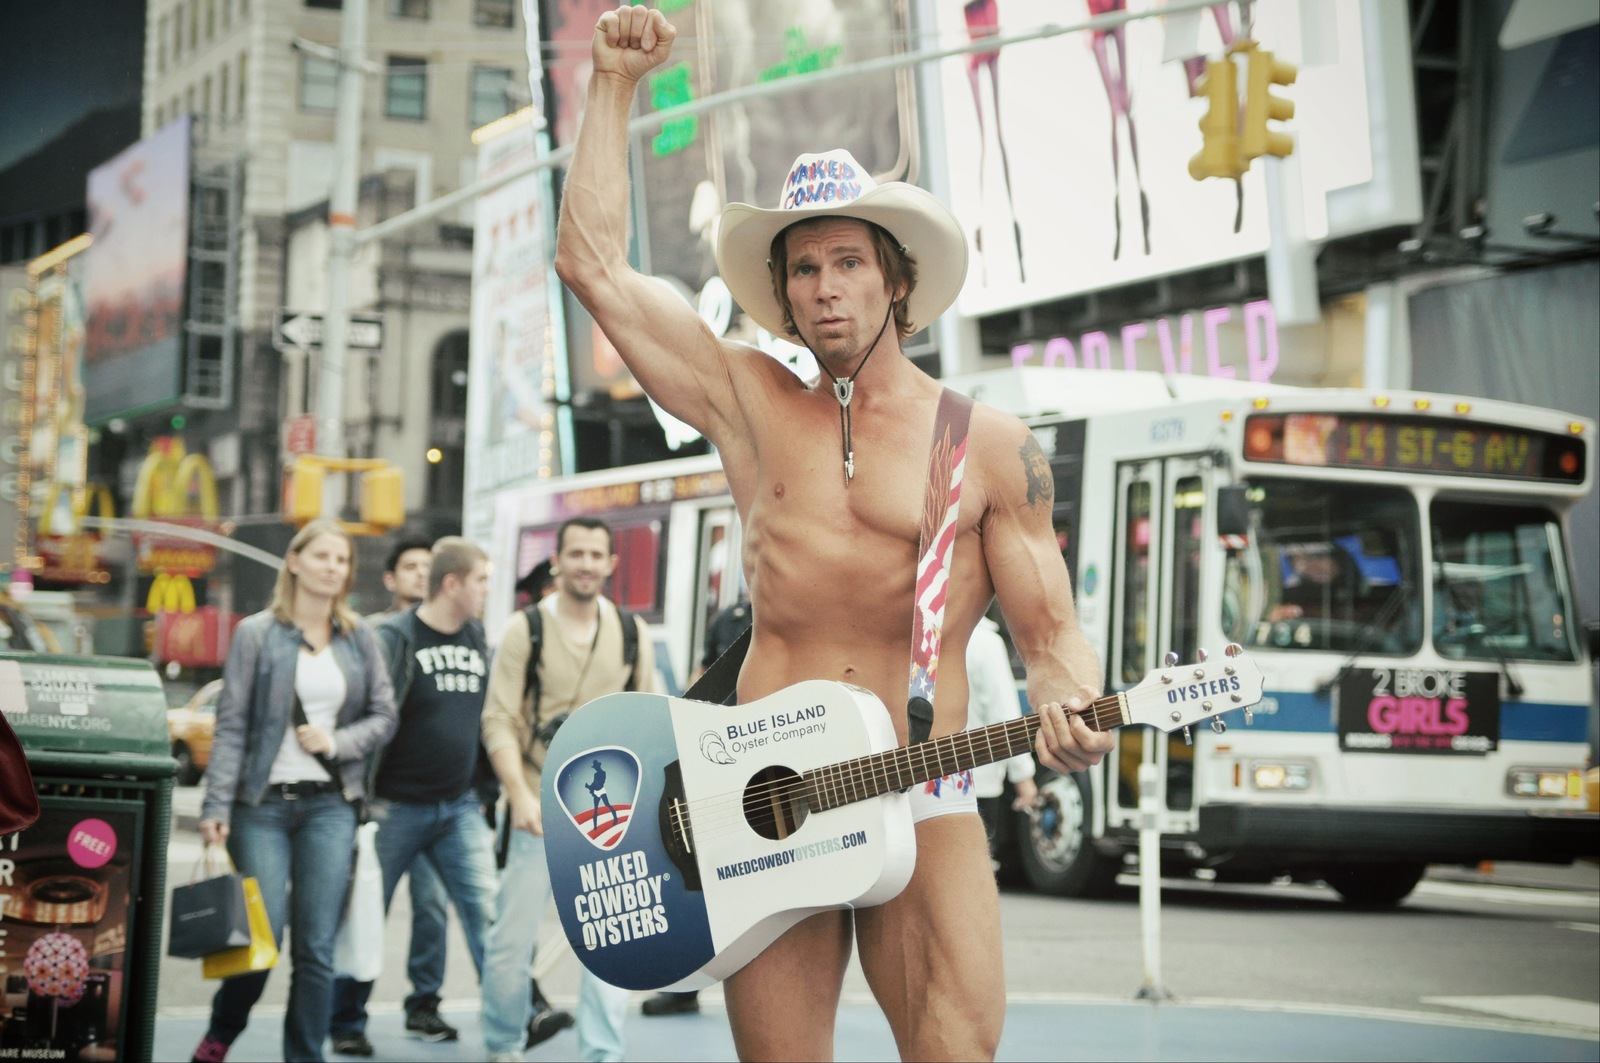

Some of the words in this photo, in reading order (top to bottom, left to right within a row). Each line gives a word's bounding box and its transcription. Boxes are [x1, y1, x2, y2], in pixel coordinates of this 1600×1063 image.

[1167, 676, 1240, 704] OYSTERS
[1371, 669, 1391, 696] 2
[726, 719, 768, 740] BLUE
[771, 704, 826, 728] ISLAND
[1367, 695, 1470, 735] GIRLS
[732, 735, 769, 754] Oyster
[772, 722, 827, 743] Company
[73, 830, 111, 857] FREE!
[716, 830, 867, 881] NAKEDCOWBOYOYSTERS.COM
[579, 850, 648, 893] NAKED
[582, 905, 669, 951] OYSTERS
